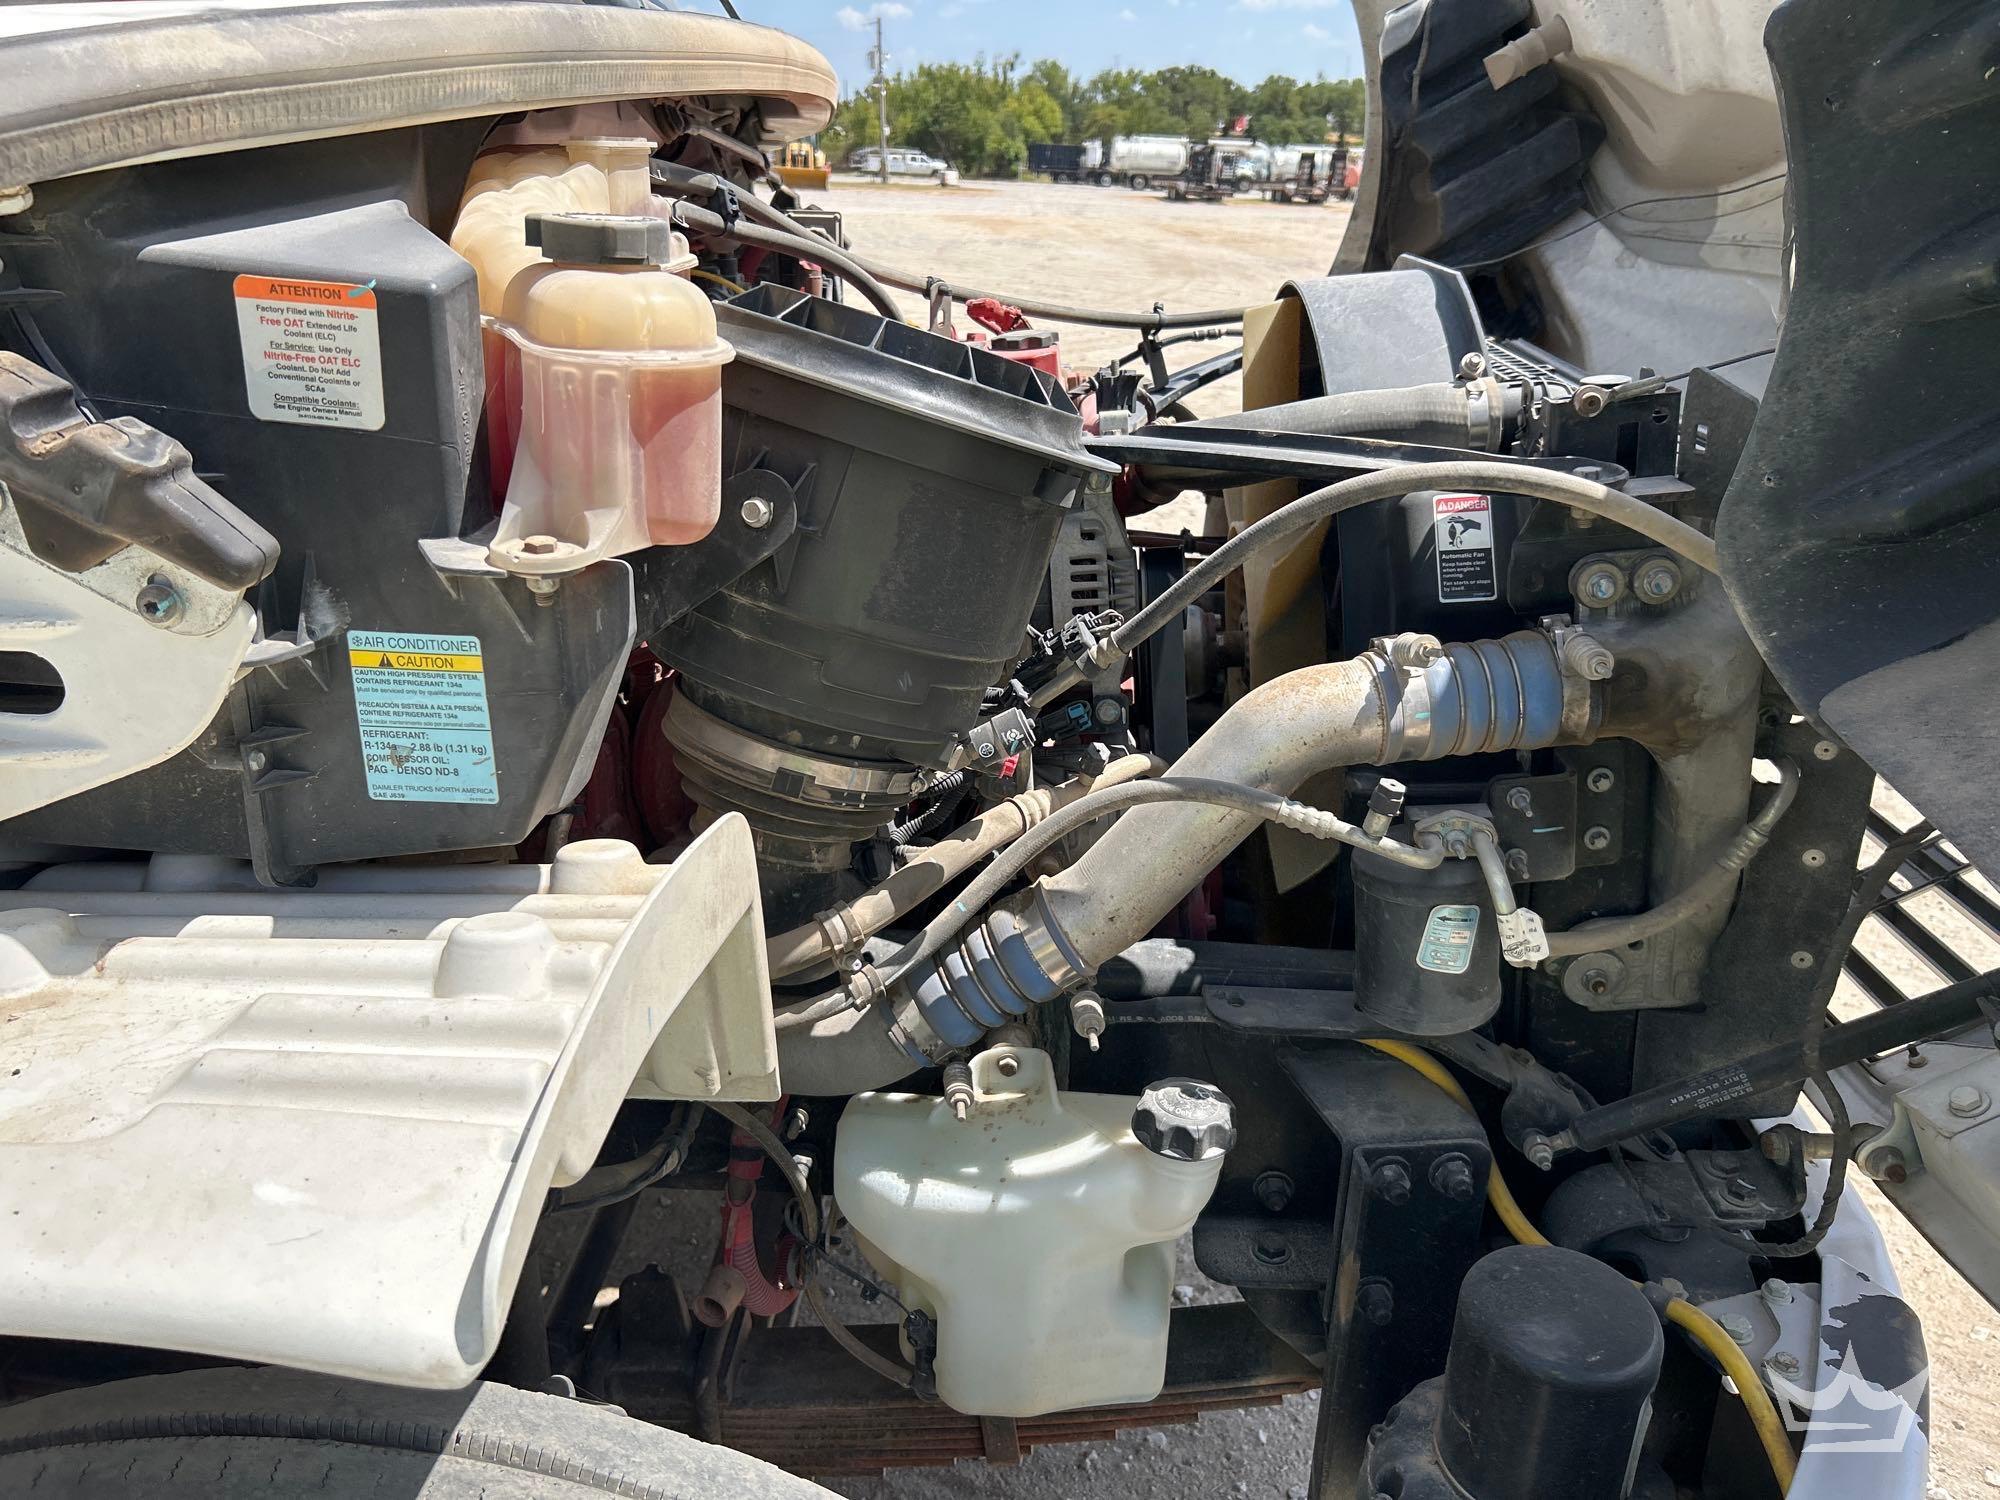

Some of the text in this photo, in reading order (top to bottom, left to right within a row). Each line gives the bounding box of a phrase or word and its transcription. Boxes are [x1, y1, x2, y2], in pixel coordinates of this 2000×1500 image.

[269, 284, 341, 299] ATTENTION
[256, 304, 358, 320] Factory Filled with Nitrite-
[260, 316, 358, 332] Free OAT Extended Life
[284, 328, 336, 342] Coolant (ELC)
[284, 342, 315, 352] Service:
[318, 345, 333, 354] Use
[334, 346, 352, 356] Only
[264, 350, 360, 368] Nitrite-Free OAT ELC
[308, 365, 320, 373] Do
[321, 367, 334, 375] Not
[336, 368, 350, 376] Add
[268, 371, 316, 382] Conventional
[318, 376, 351, 386] Coolants
[304, 384, 326, 392] SCAs
[274, 393, 360, 408] Compatible Coolants:
[288, 404, 310, 413] Engine
[312, 406, 338, 414] Owners
[1447, 500, 1487, 511] DANGER
[364, 636, 478, 652] AIR CONDITIONER
[396, 656, 454, 669] CAUTION
[354, 669, 386, 677] CAUTION
[393, 680, 444, 688] REFRIGERANT
[358, 702, 400, 710] PRECAUCIÓN
[362, 730, 430, 740] REFRIGERANT:
[364, 740, 397, 750] R-134a
[410, 743, 430, 752] 2.88
[446, 744, 469, 754] (1.31
[472, 745, 487, 756] kg)
[432, 756, 450, 764] OIL:
[368, 765, 388, 774] PAG
[397, 766, 432, 775] DENSO
[436, 768, 459, 776] ND-8
[372, 784, 402, 792] DAIMLER
